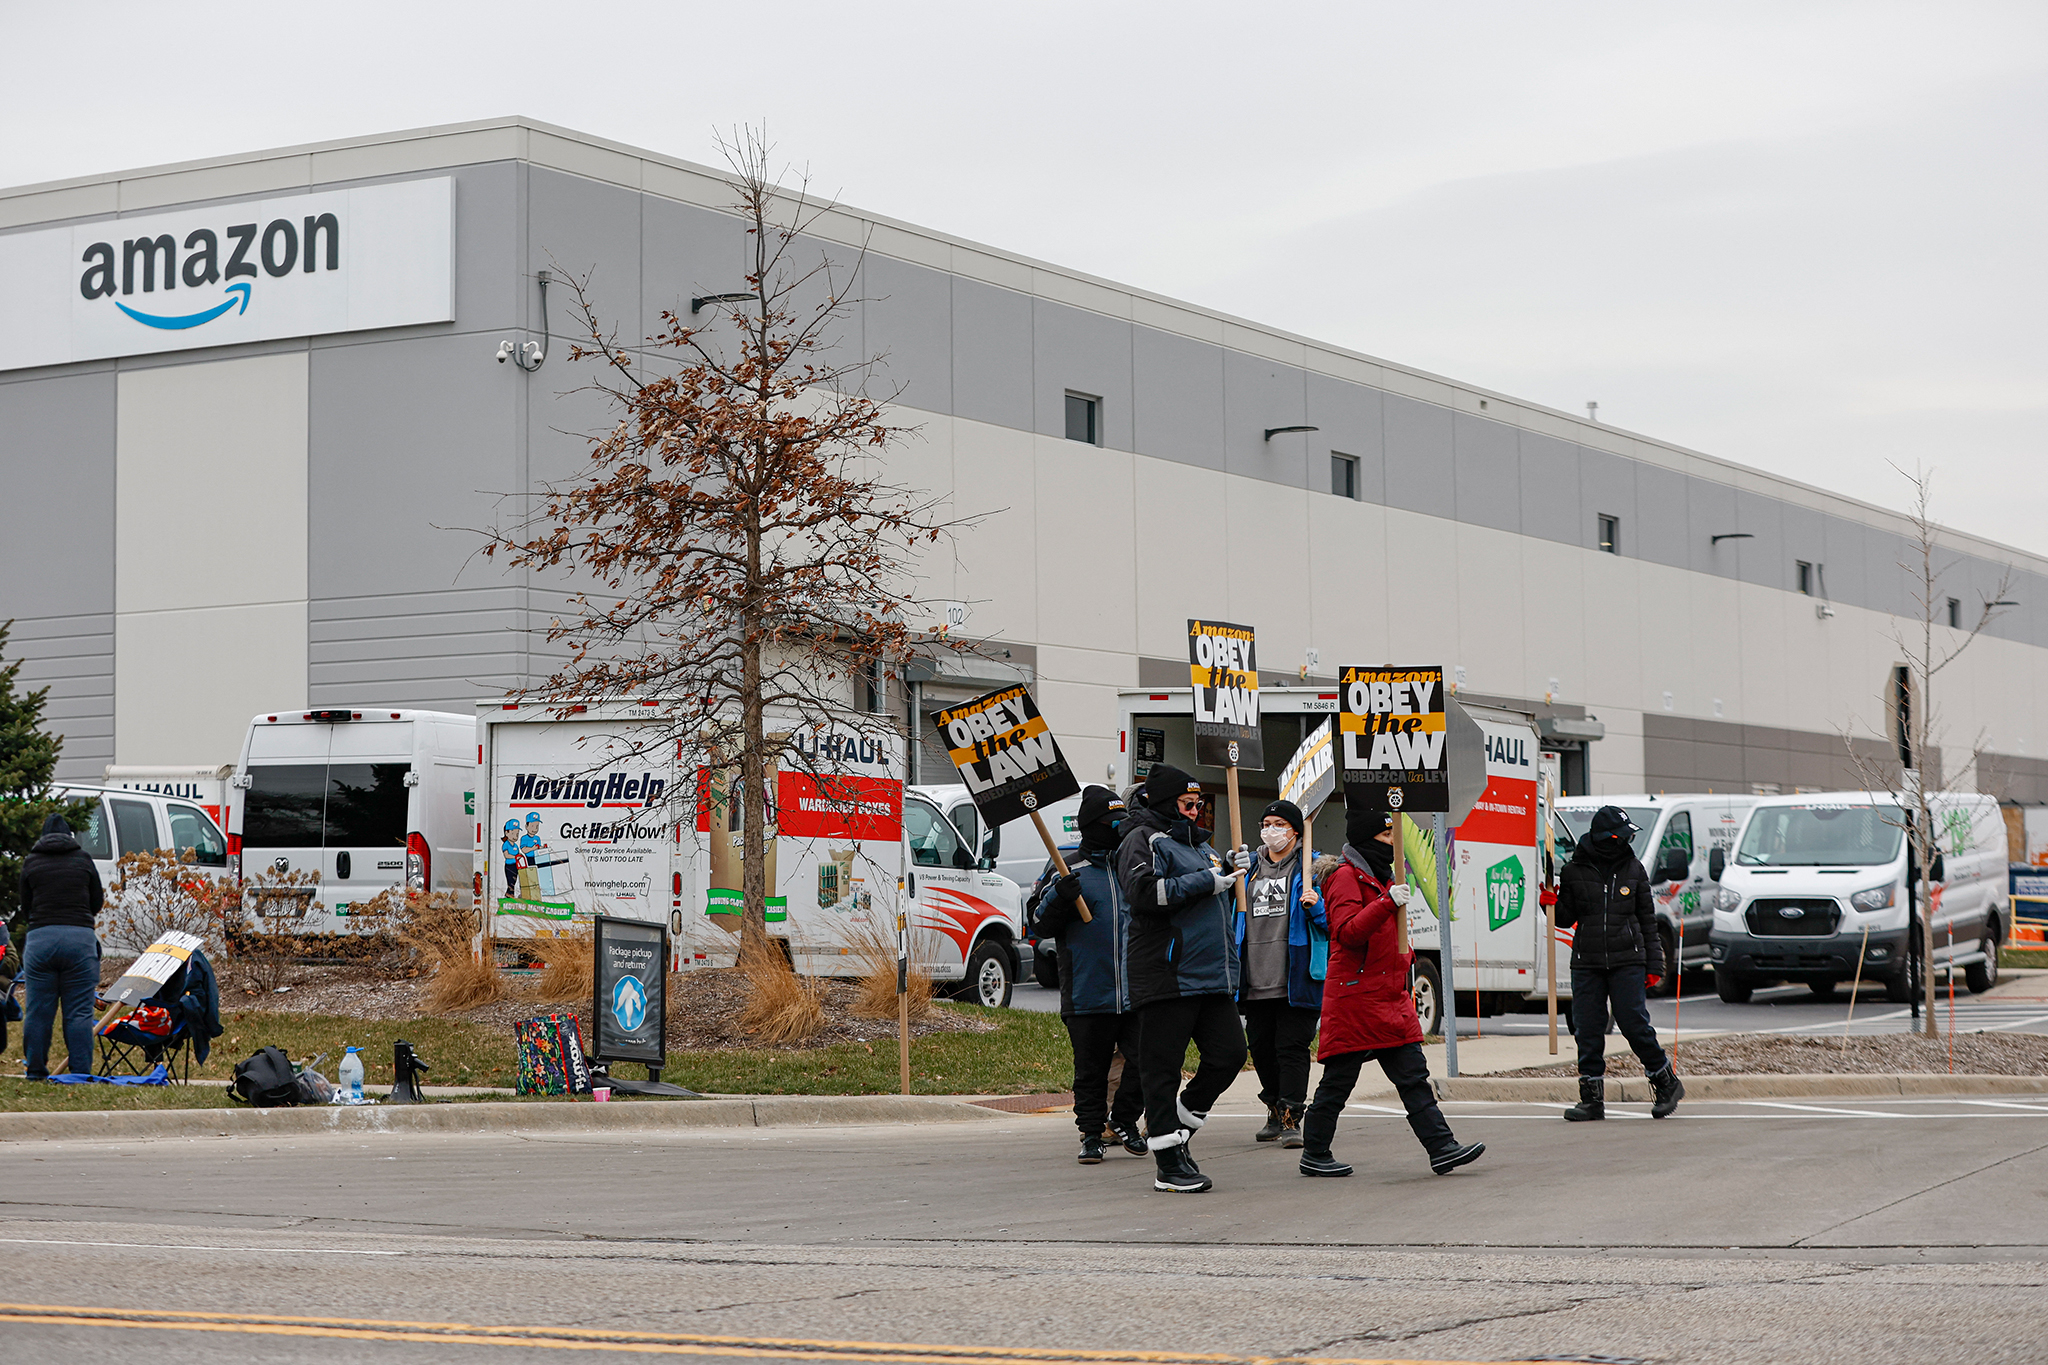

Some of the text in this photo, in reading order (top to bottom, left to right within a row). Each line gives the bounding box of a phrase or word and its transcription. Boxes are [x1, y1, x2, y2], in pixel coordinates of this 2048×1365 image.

[80, 212, 339, 300] amazon
[948, 608, 963, 624] 102
[1190, 620, 1255, 642] Amazon:
[1196, 633, 1251, 673] OBEY
[1207, 666, 1247, 689] the
[1341, 667, 1442, 684] Amazon:
[937, 687, 1027, 727] Amazon:
[1194, 683, 1260, 727] LAW
[1347, 680, 1435, 716] OBEY
[948, 695, 1029, 749] OBEY
[1195, 723, 1240, 738] OBEDEZCA
[1362, 711, 1423, 736] the
[799, 733, 889, 765] U-HAUL
[971, 728, 1029, 761] the
[1281, 720, 1329, 792] AMAZON
[1343, 731, 1446, 770] LAW
[959, 730, 1057, 795] LAW
[1343, 770, 1407, 783] OBEDEZCA
[1425, 771, 1448, 783] LEY
[510, 773, 665, 808] MovingHelp
[1508, 804, 1527, 816] RENTALS
[559, 822, 667, 843] Get Help Now!
[585, 881, 646, 889] movinghelp.com
[608, 945, 653, 960] Package pickup
[612, 959, 646, 970] and returns
